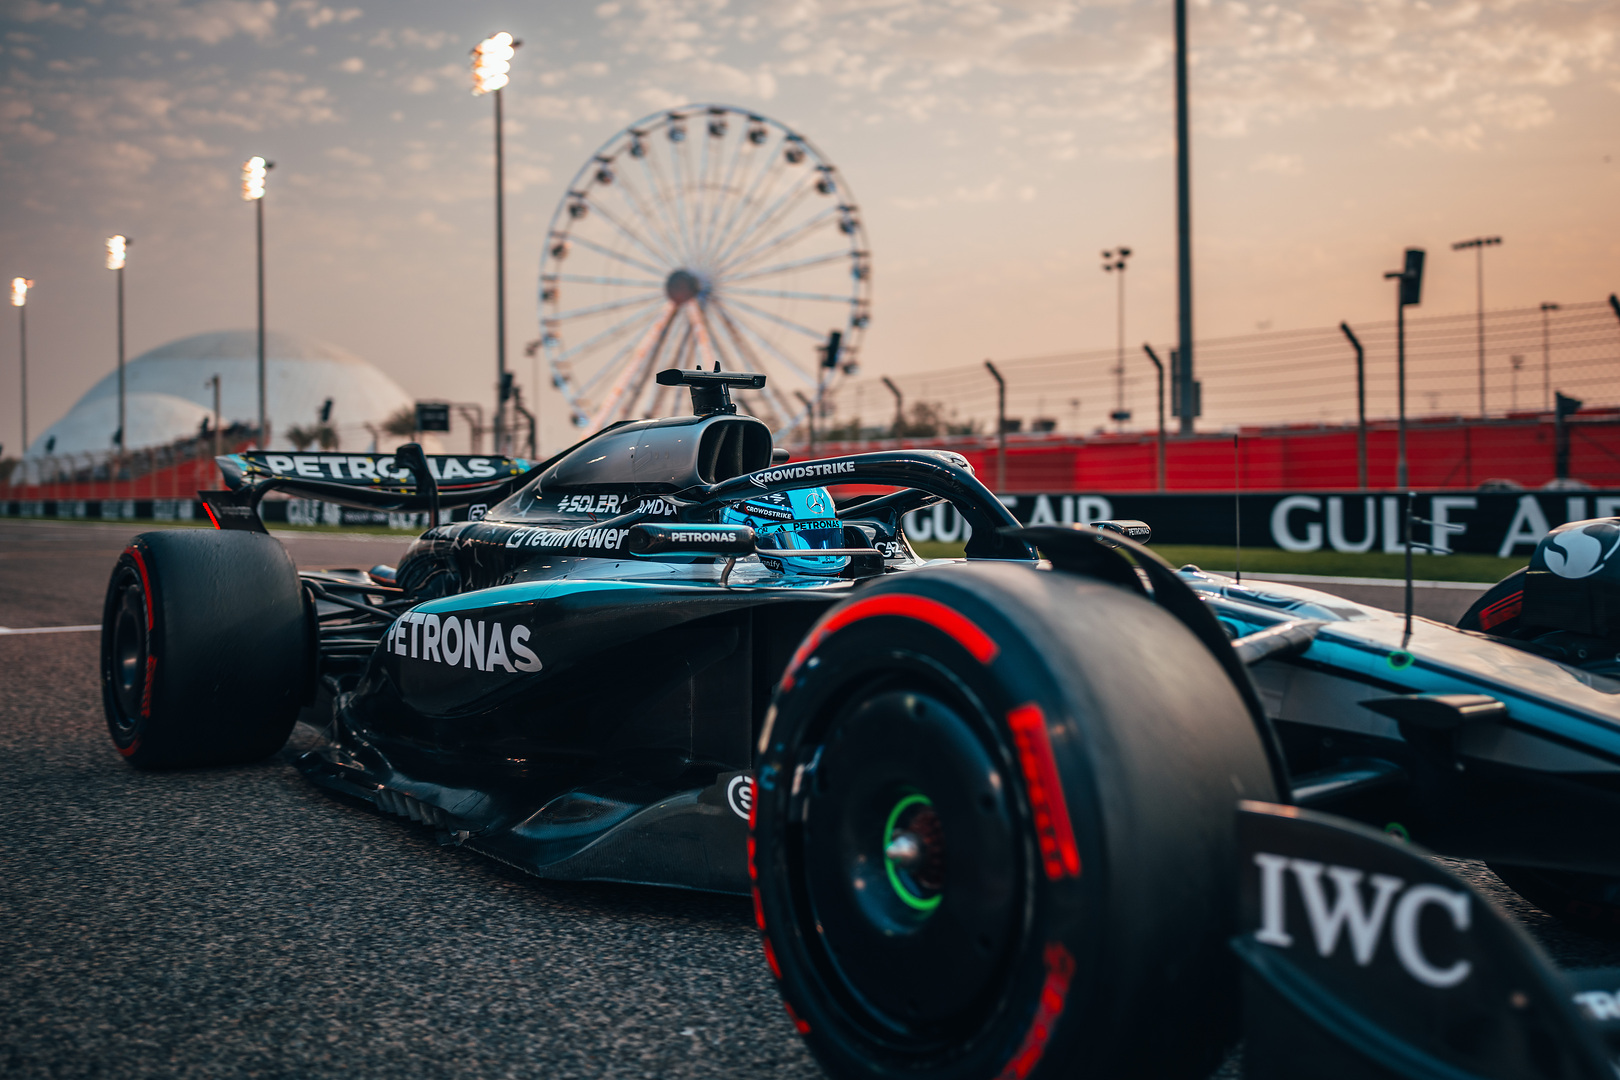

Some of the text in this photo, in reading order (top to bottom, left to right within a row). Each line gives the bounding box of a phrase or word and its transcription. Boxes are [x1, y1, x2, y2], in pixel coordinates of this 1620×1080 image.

[756, 461, 856, 483] CROWDSTRIKE
[638, 499, 665, 514] AMD
[746, 505, 792, 520] CROWDSTRIKE
[793, 520, 840, 530] PETRONAS
[1270, 495, 1478, 556] GULF
[522, 527, 630, 550] TeamViewer
[671, 532, 737, 542] PETRONAS
[387, 611, 543, 673] PETRONAS
[1252, 852, 1473, 989] IWC
